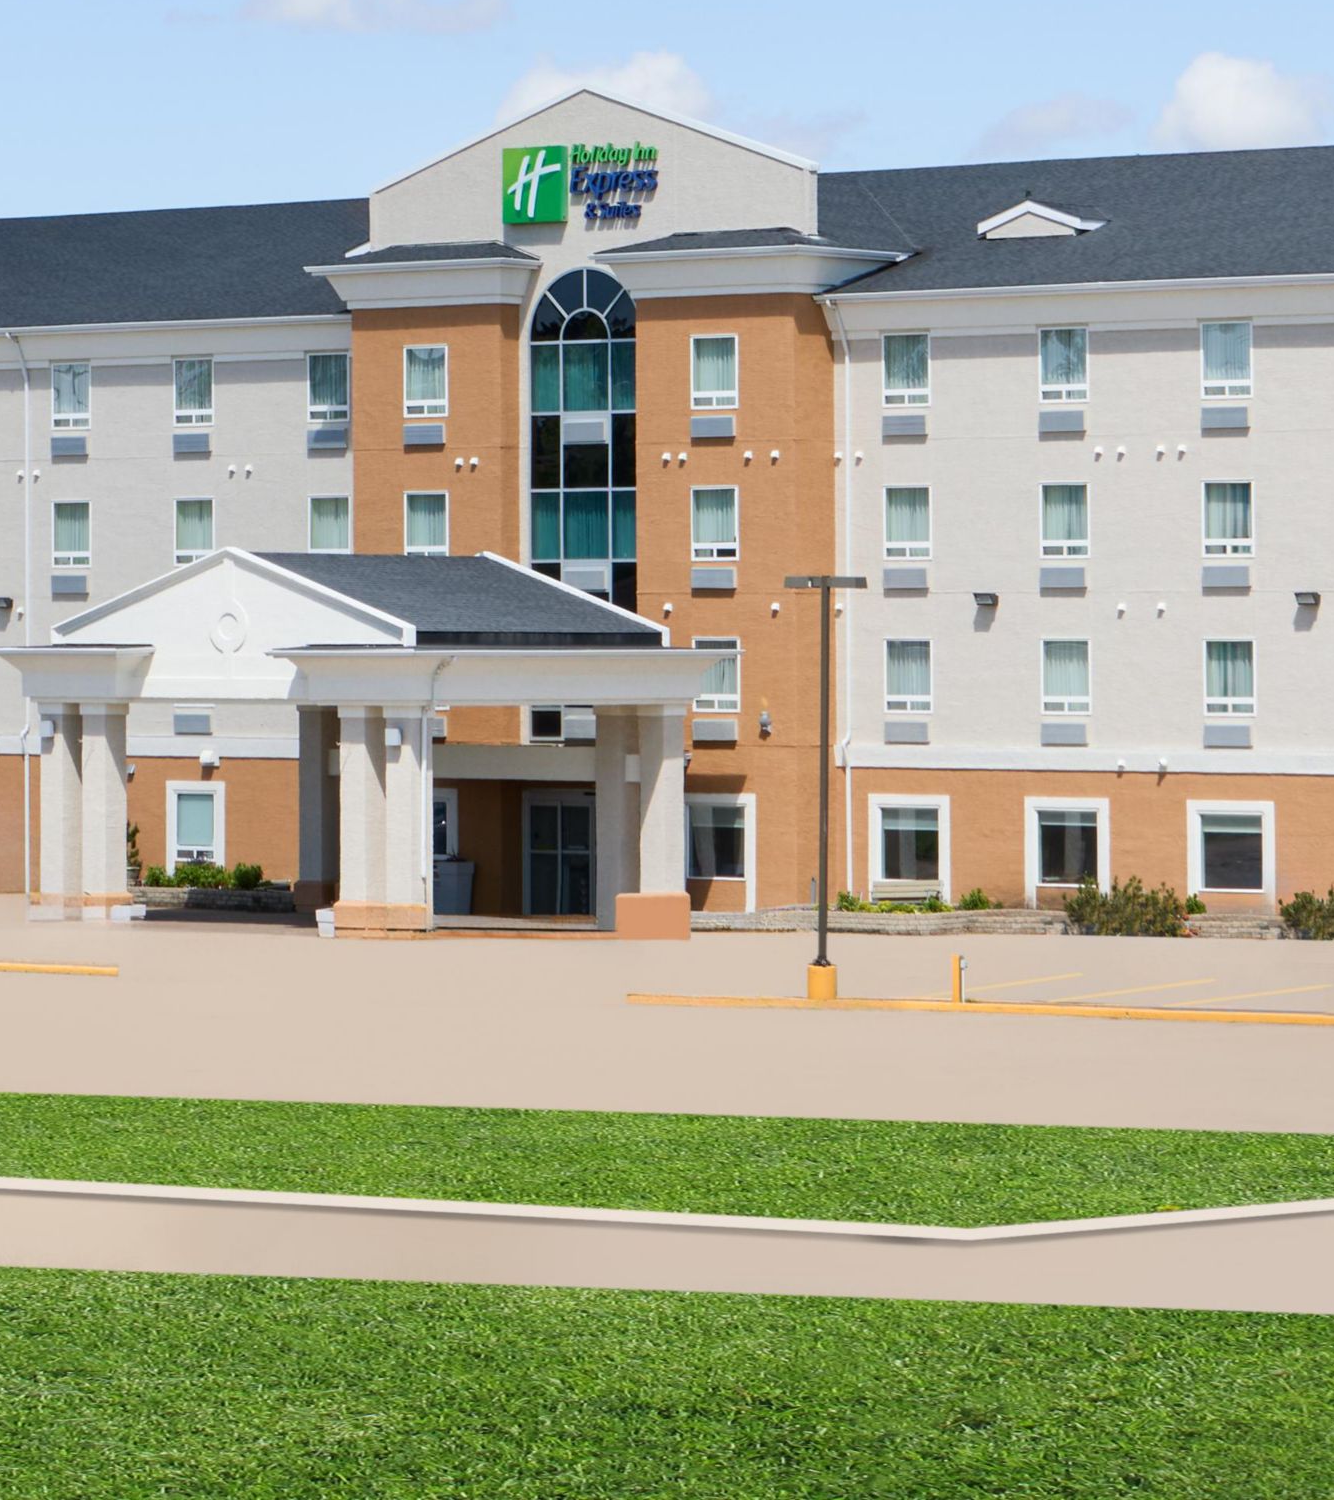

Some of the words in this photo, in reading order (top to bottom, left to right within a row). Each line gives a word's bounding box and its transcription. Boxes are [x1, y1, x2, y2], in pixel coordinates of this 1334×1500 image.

[570, 143, 632, 167] Holiday
[632, 141, 659, 162] Inn
[569, 166, 659, 201] Express
[584, 202, 598, 219] &
[598, 201, 642, 219] Suites
